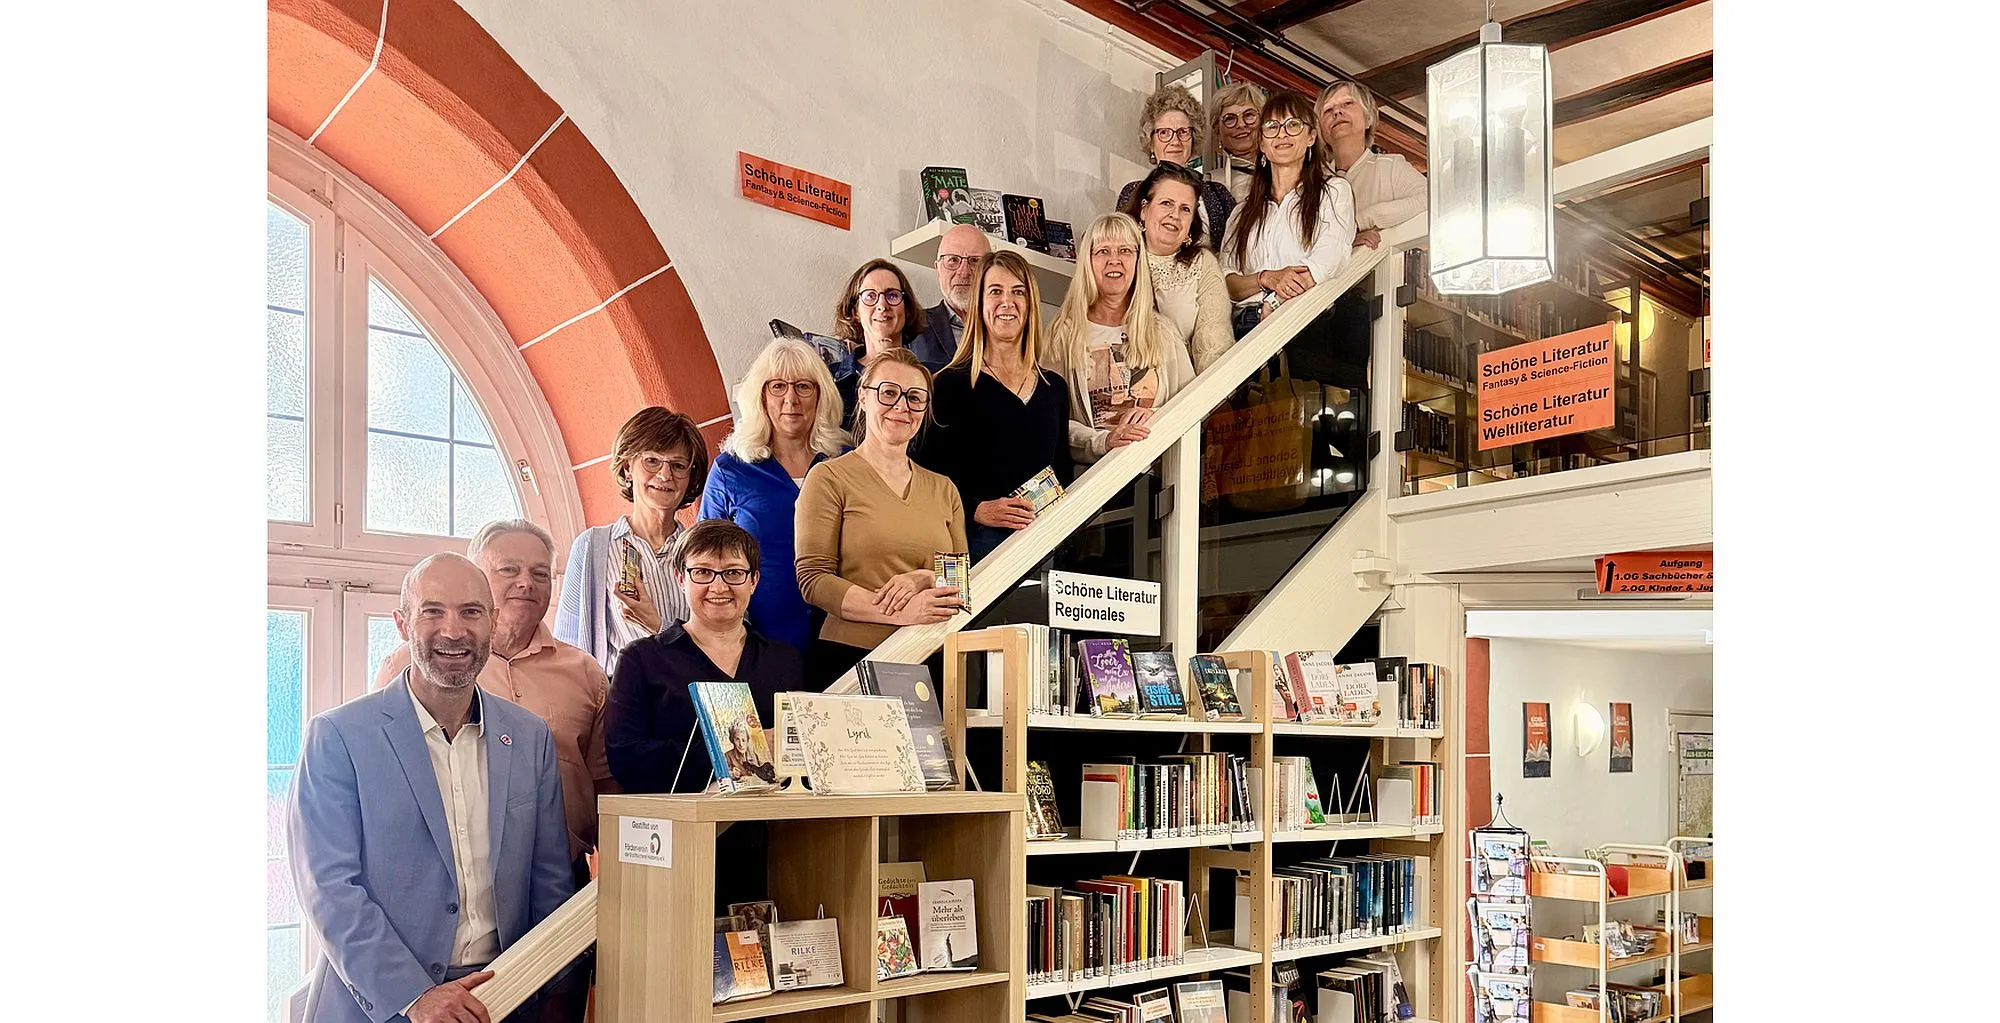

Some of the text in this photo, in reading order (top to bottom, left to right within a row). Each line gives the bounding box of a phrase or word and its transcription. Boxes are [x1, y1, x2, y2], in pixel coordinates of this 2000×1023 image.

[744, 163, 849, 206] Schöne Literatur
[931, 174, 968, 188] MATE
[786, 192, 848, 220] Science-Fiction
[1482, 339, 1610, 377] Schöne Literatur
[1530, 356, 1608, 380] Science-Fiction
[1483, 387, 1610, 422] Schöne Literatur
[1482, 413, 1575, 440] Weltliteratur
[1659, 560, 1703, 569] Aufgang
[1614, 572, 1639, 581] 1.OG
[1641, 571, 1704, 580] Sachbücher
[1055, 580, 1158, 604] Schöne Literatur
[1620, 584, 1646, 592] 2.OG
[1648, 584, 1683, 592] Kinder
[1055, 602, 1125, 622] Regionales
[1144, 684, 1171, 696] EISIGE
[1310, 680, 1335, 688] LADEN
[1346, 682, 1369, 690] DORF
[1343, 688, 1373, 696] LADEN
[1149, 694, 1183, 706] STILLE
[1027, 785, 1052, 795] MORD
[932, 905, 963, 914] Mehr als
[931, 913, 966, 923] überleben
[791, 946, 817, 955] RILKE
[733, 959, 764, 971] RILKE
